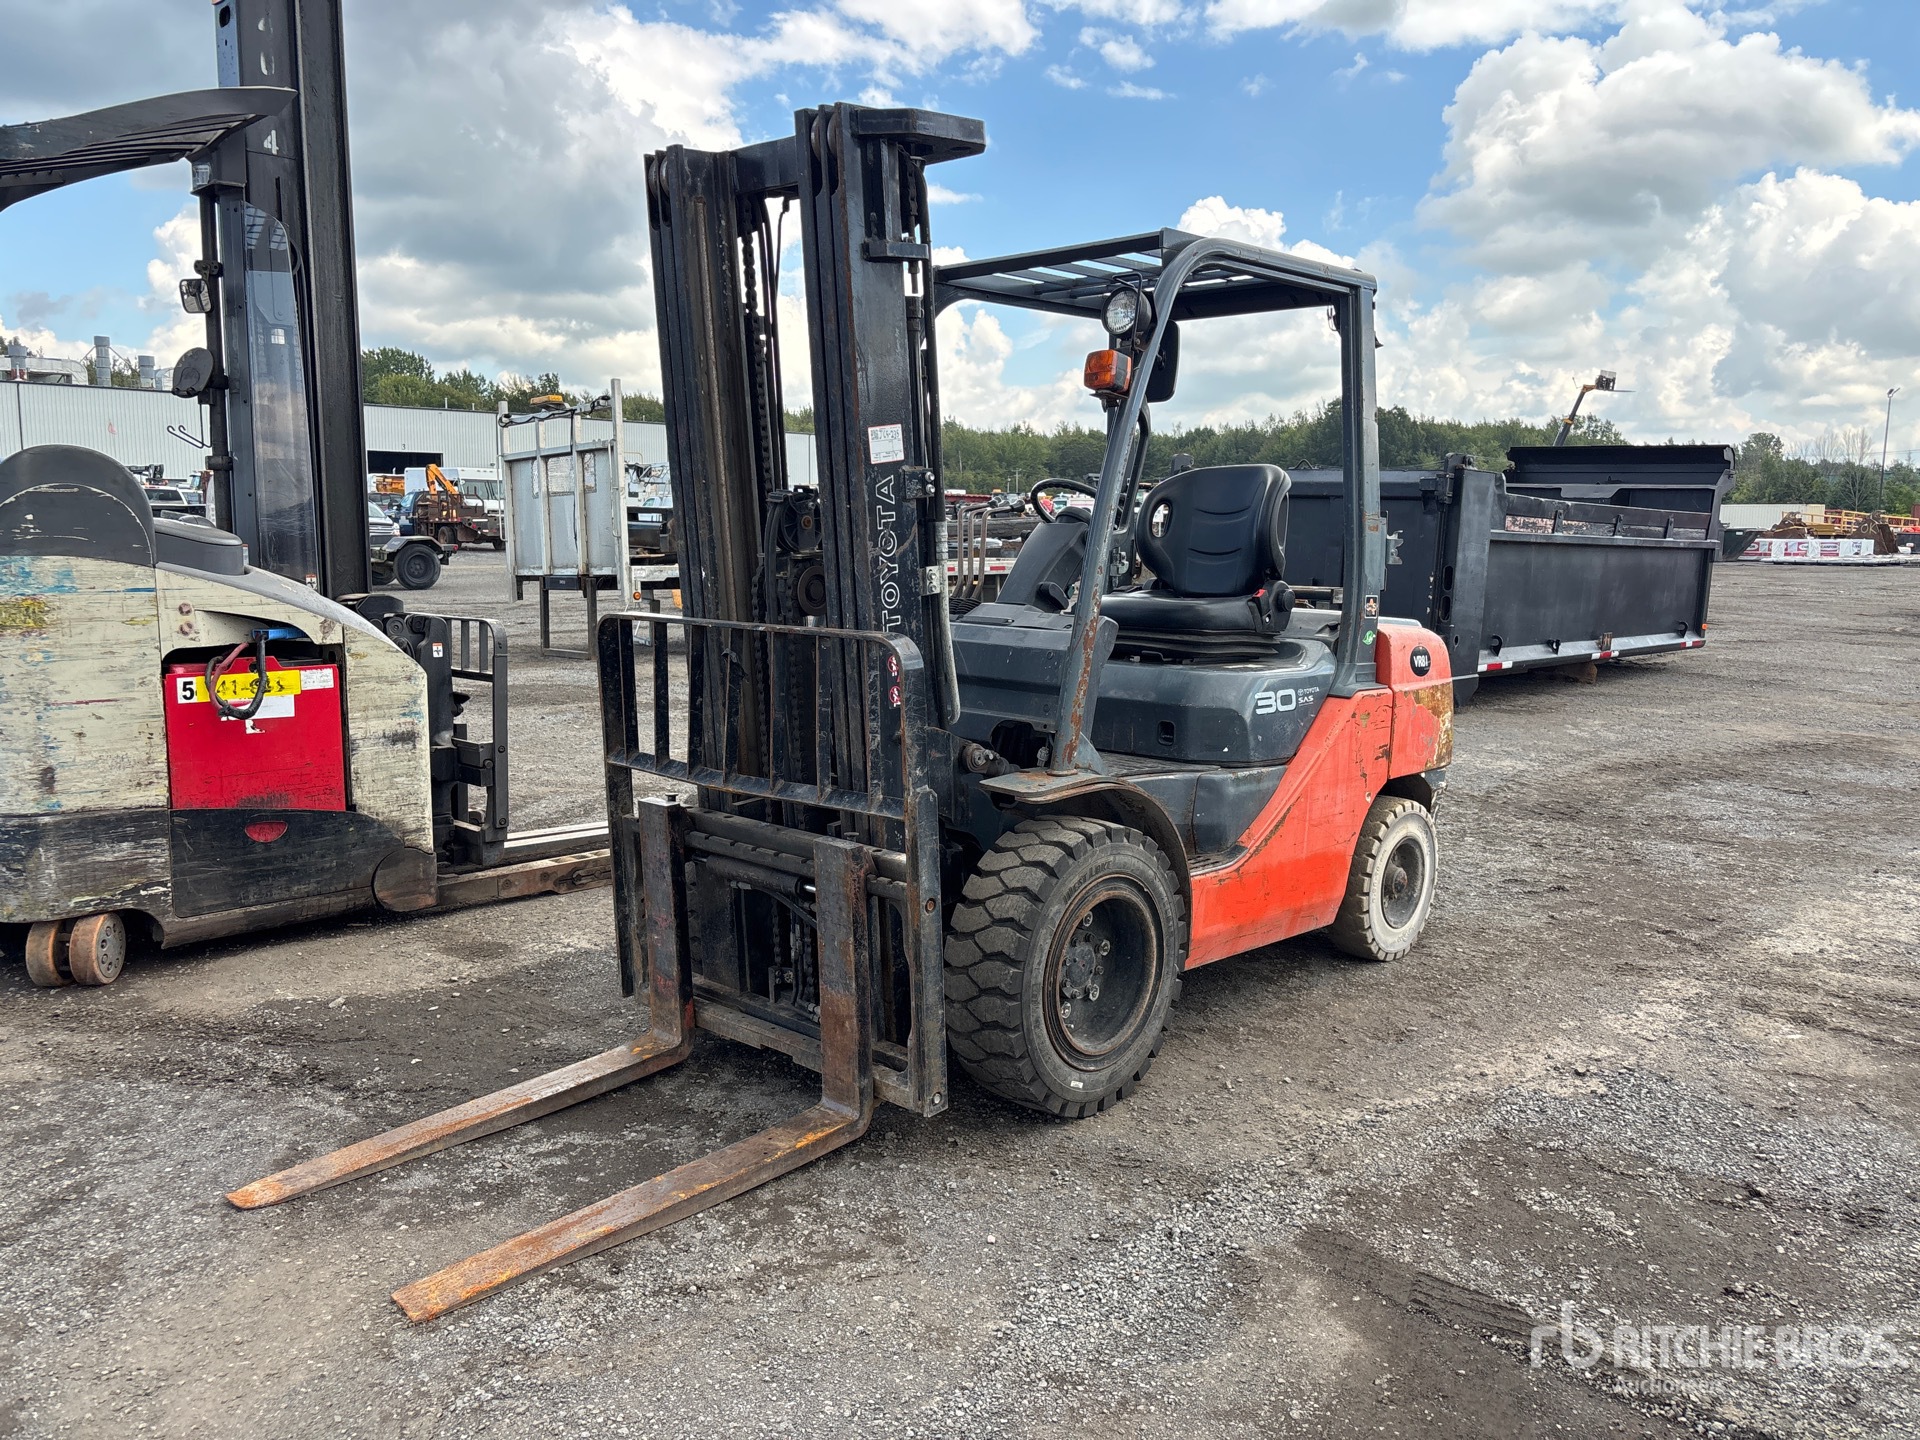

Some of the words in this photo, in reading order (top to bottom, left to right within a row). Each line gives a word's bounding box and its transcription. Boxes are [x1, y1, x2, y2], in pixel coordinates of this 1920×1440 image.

[263, 129, 279, 156] 4
[1860, 523, 1877, 535] OK
[875, 474, 901, 633] TOYOTA
[181, 680, 195, 701] 5
[1254, 688, 1297, 715] 30
[1303, 686, 1320, 695] TOYOTA
[1298, 695, 1314, 704] SAS
